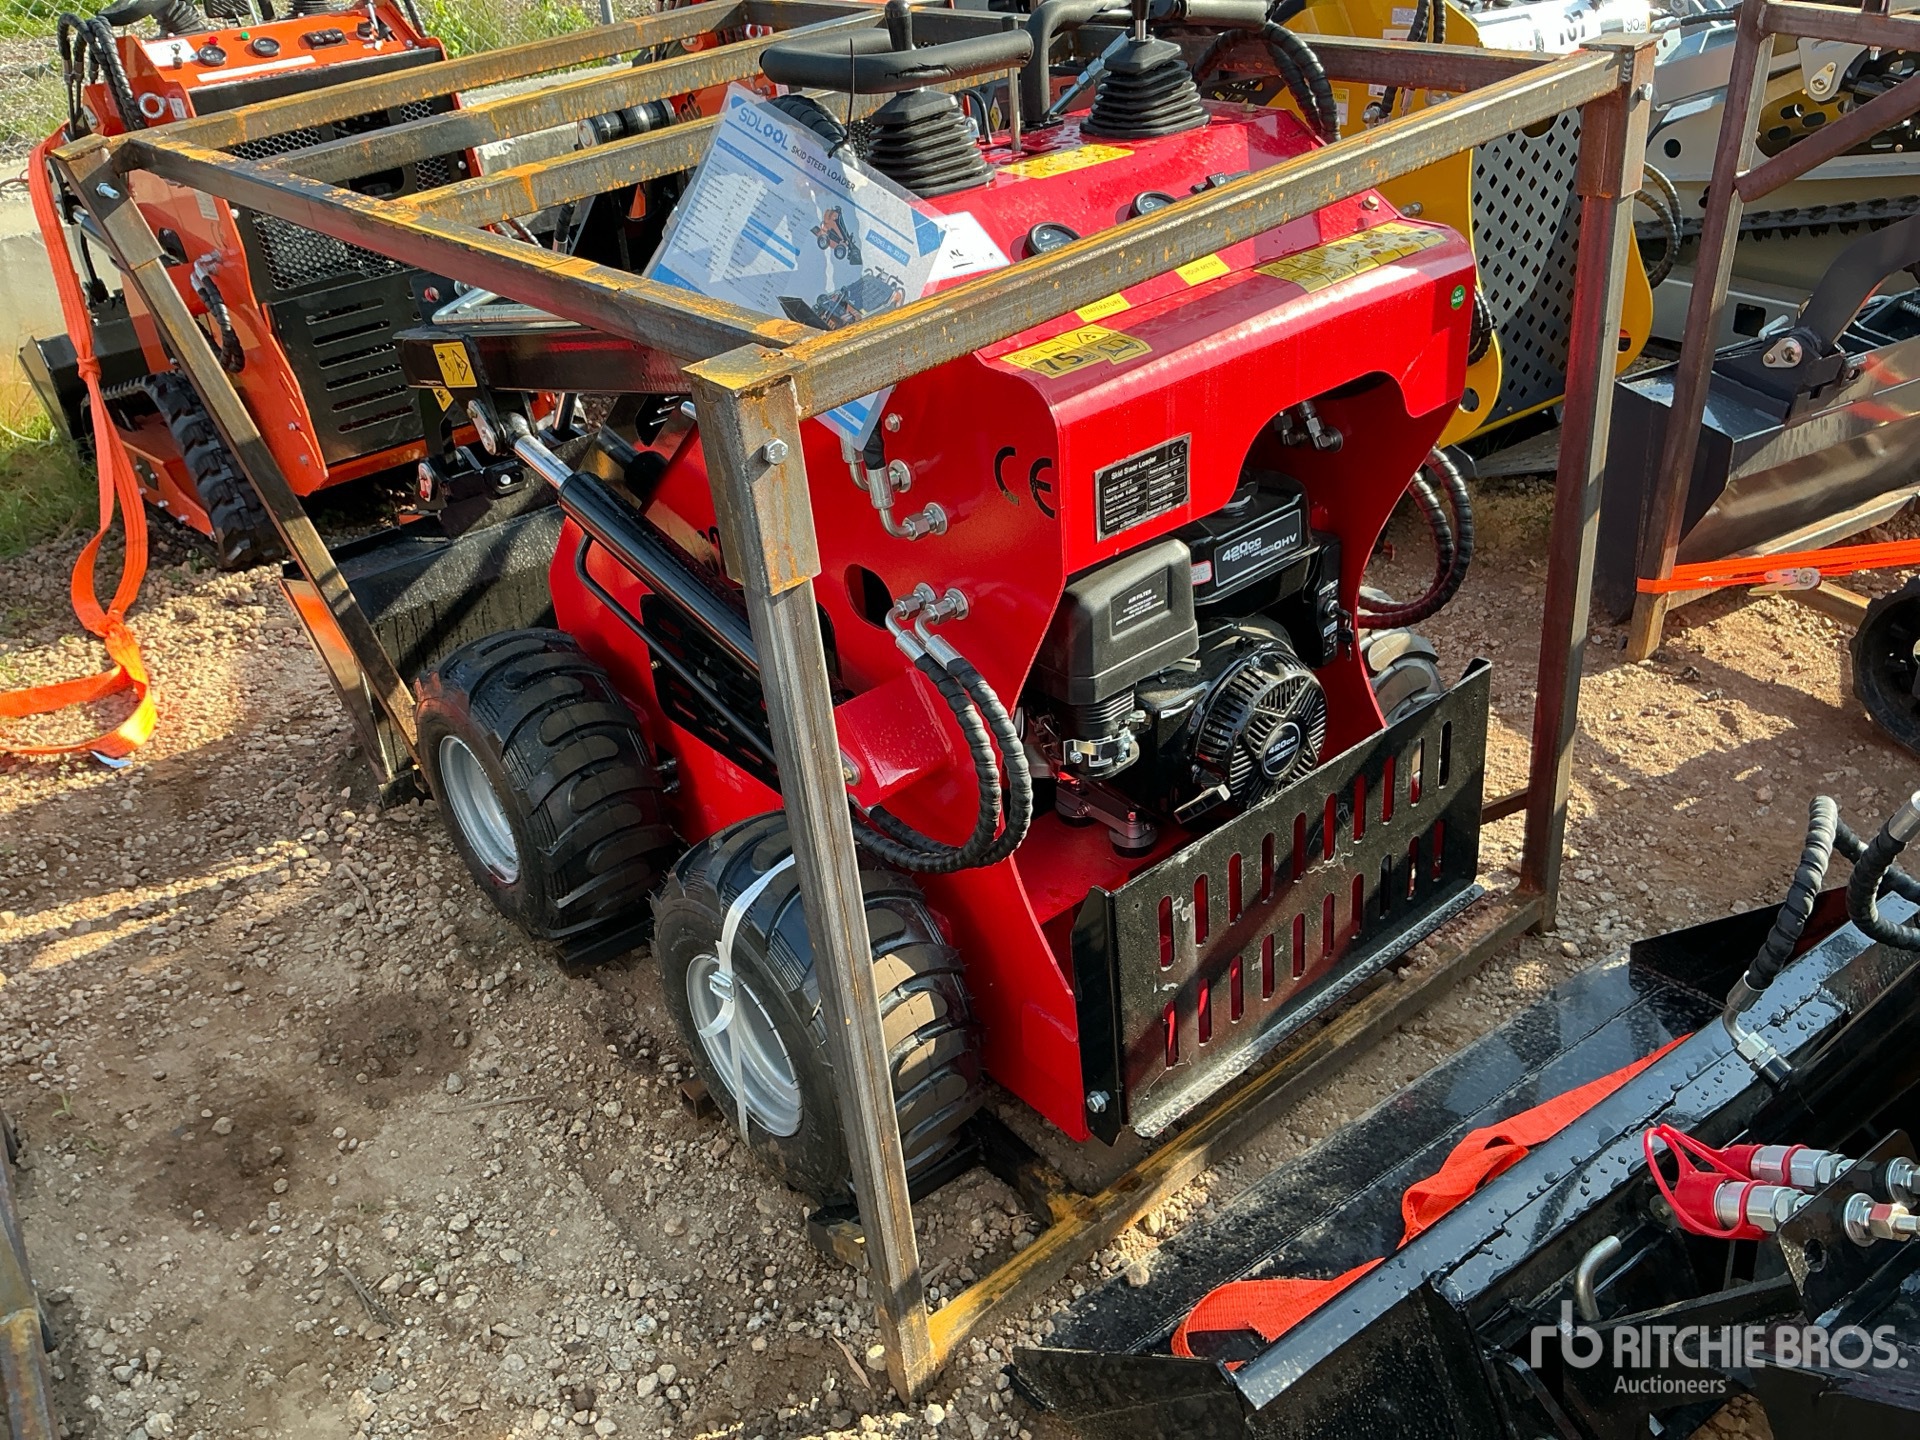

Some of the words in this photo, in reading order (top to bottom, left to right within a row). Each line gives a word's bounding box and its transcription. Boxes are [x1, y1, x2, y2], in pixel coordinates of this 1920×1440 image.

[738, 106, 789, 151] SDLOOL
[790, 145, 807, 160] SKID
[806, 154, 828, 174] STEER
[826, 166, 856, 193] LOADER
[1200, 260, 1218, 271] METER
[1081, 299, 1122, 316] TEMPERATURE
[1030, 352, 1084, 371] 75
[1111, 468, 1124, 480] Skid
[1138, 455, 1157, 469] Loader
[1222, 537, 1262, 562] 420cc
[1273, 532, 1297, 551] OHV
[1268, 735, 1296, 754] 420cc
